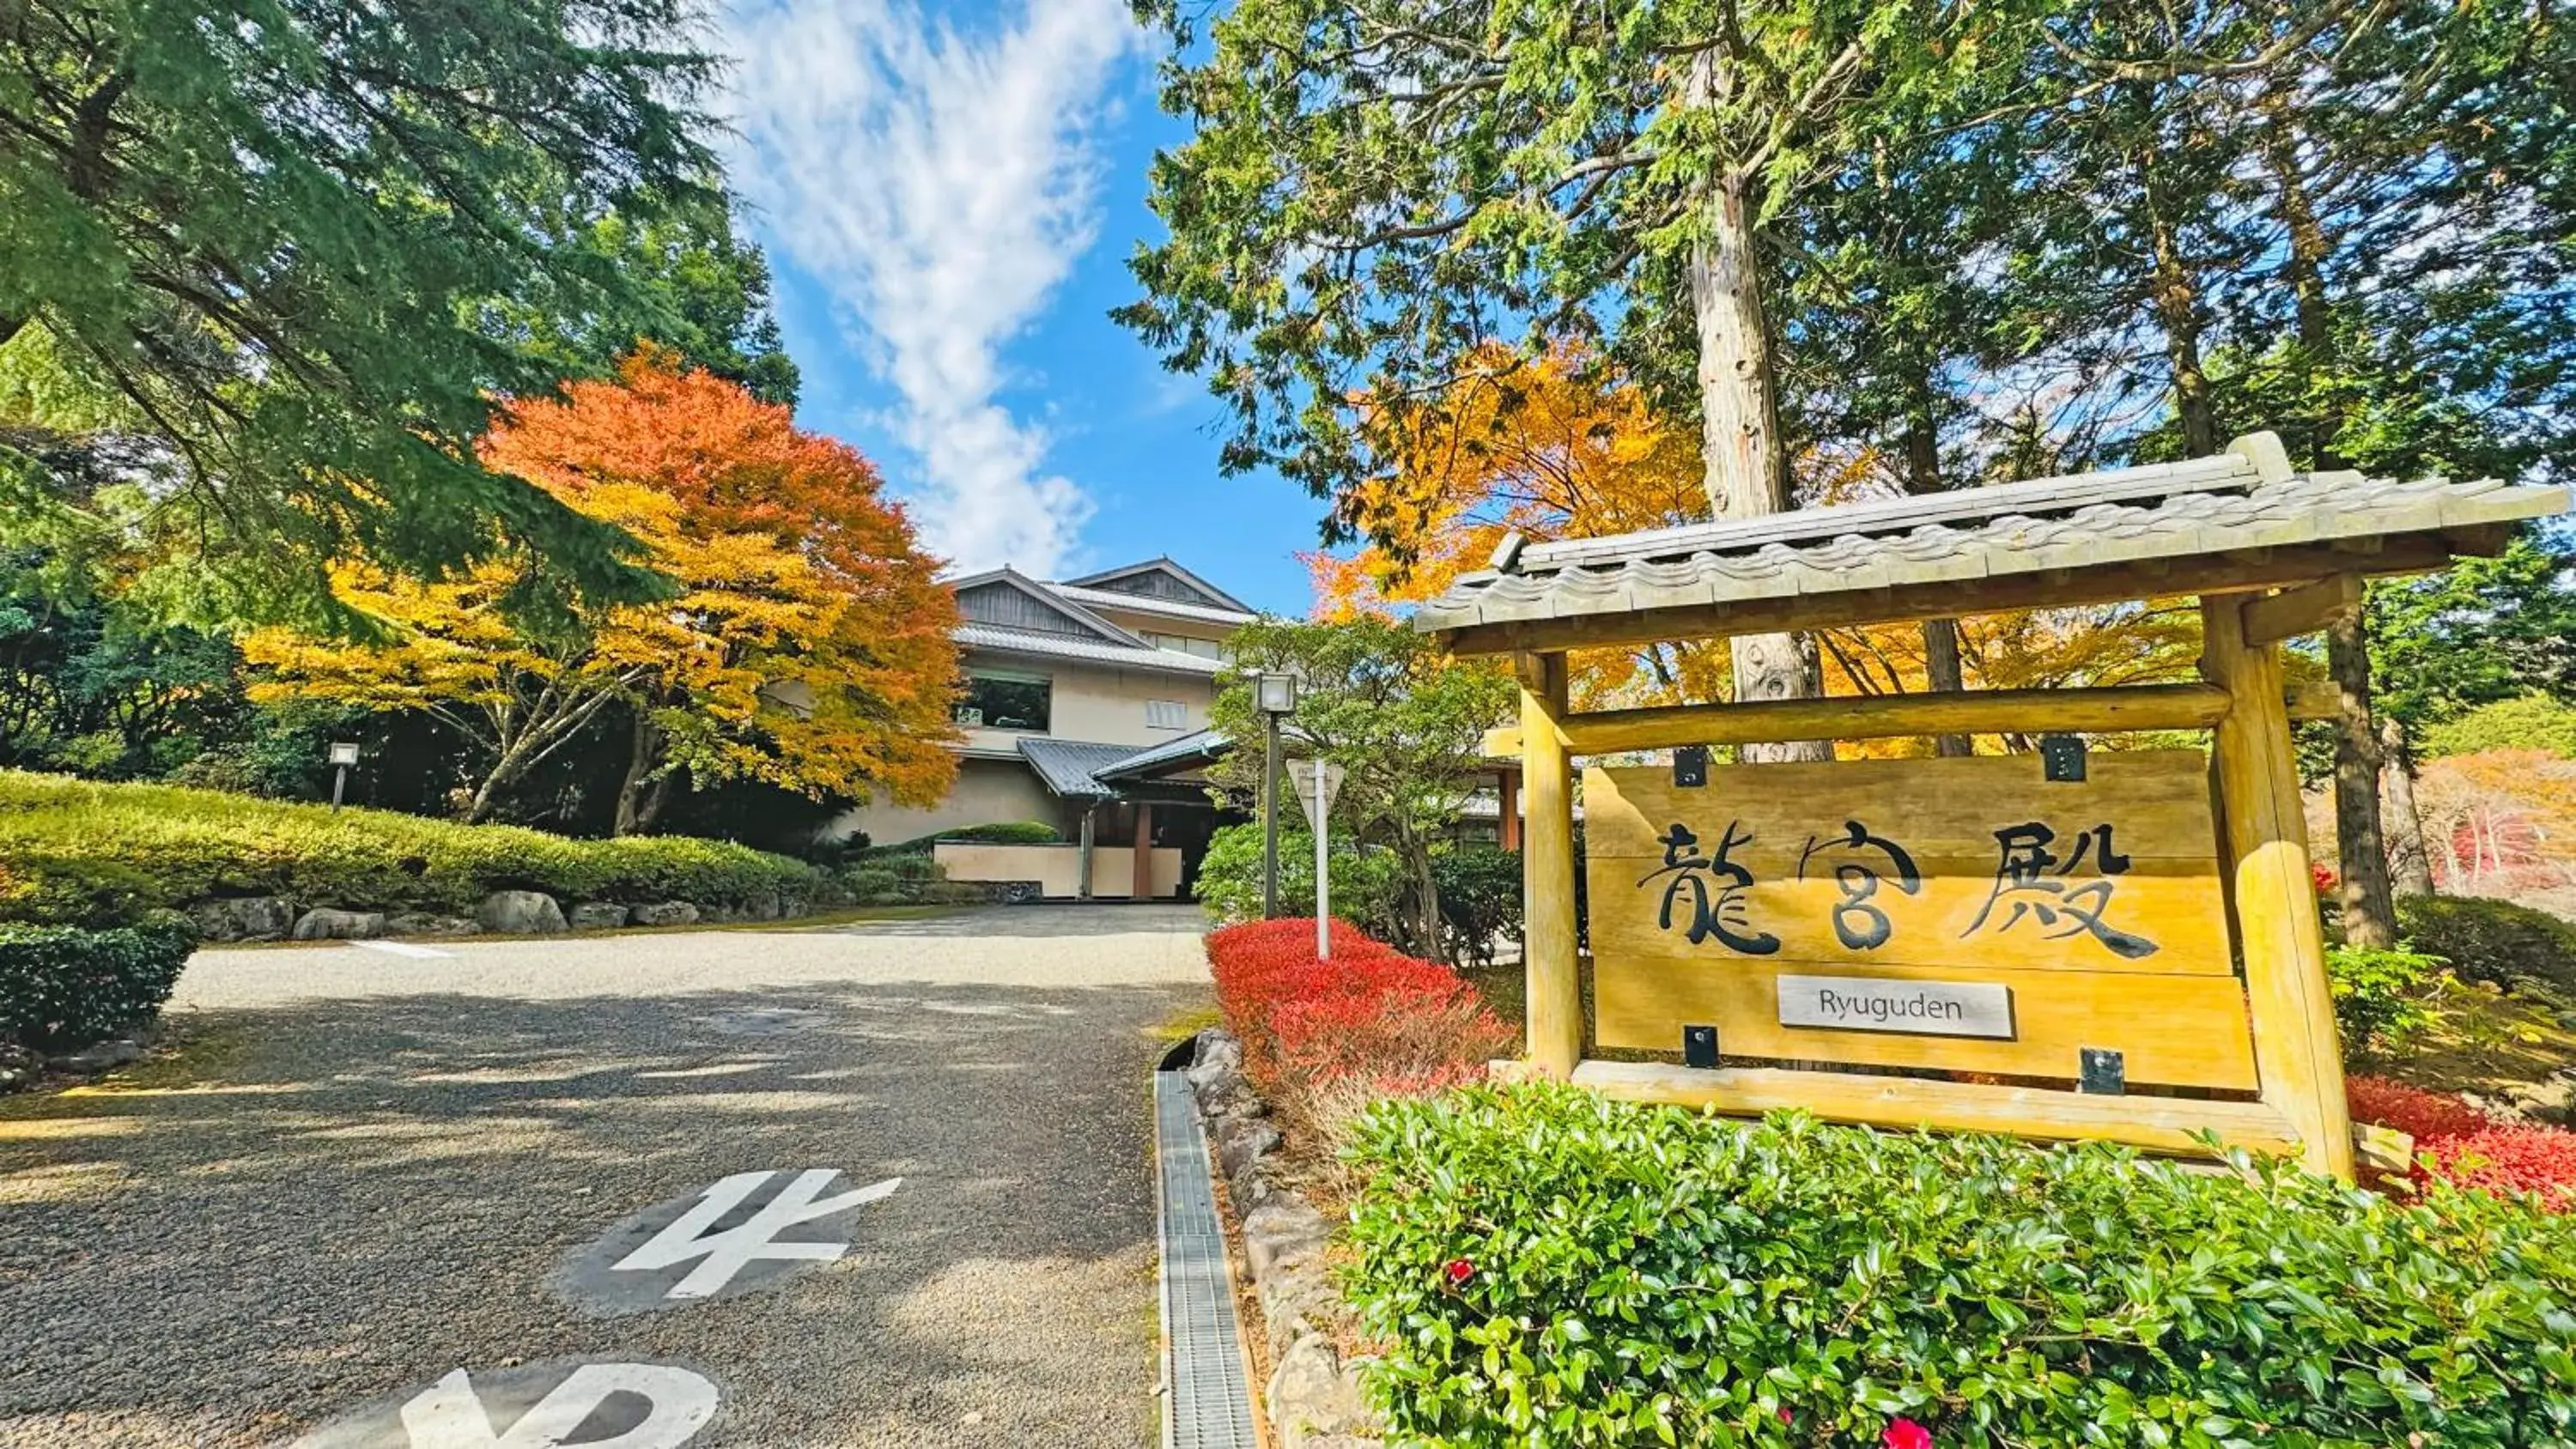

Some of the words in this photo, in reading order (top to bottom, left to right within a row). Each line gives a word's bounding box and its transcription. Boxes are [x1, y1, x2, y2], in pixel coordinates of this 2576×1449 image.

[1636, 820, 2160, 959] 龍宮殿
[1820, 988, 1963, 1022] Ryuguden
